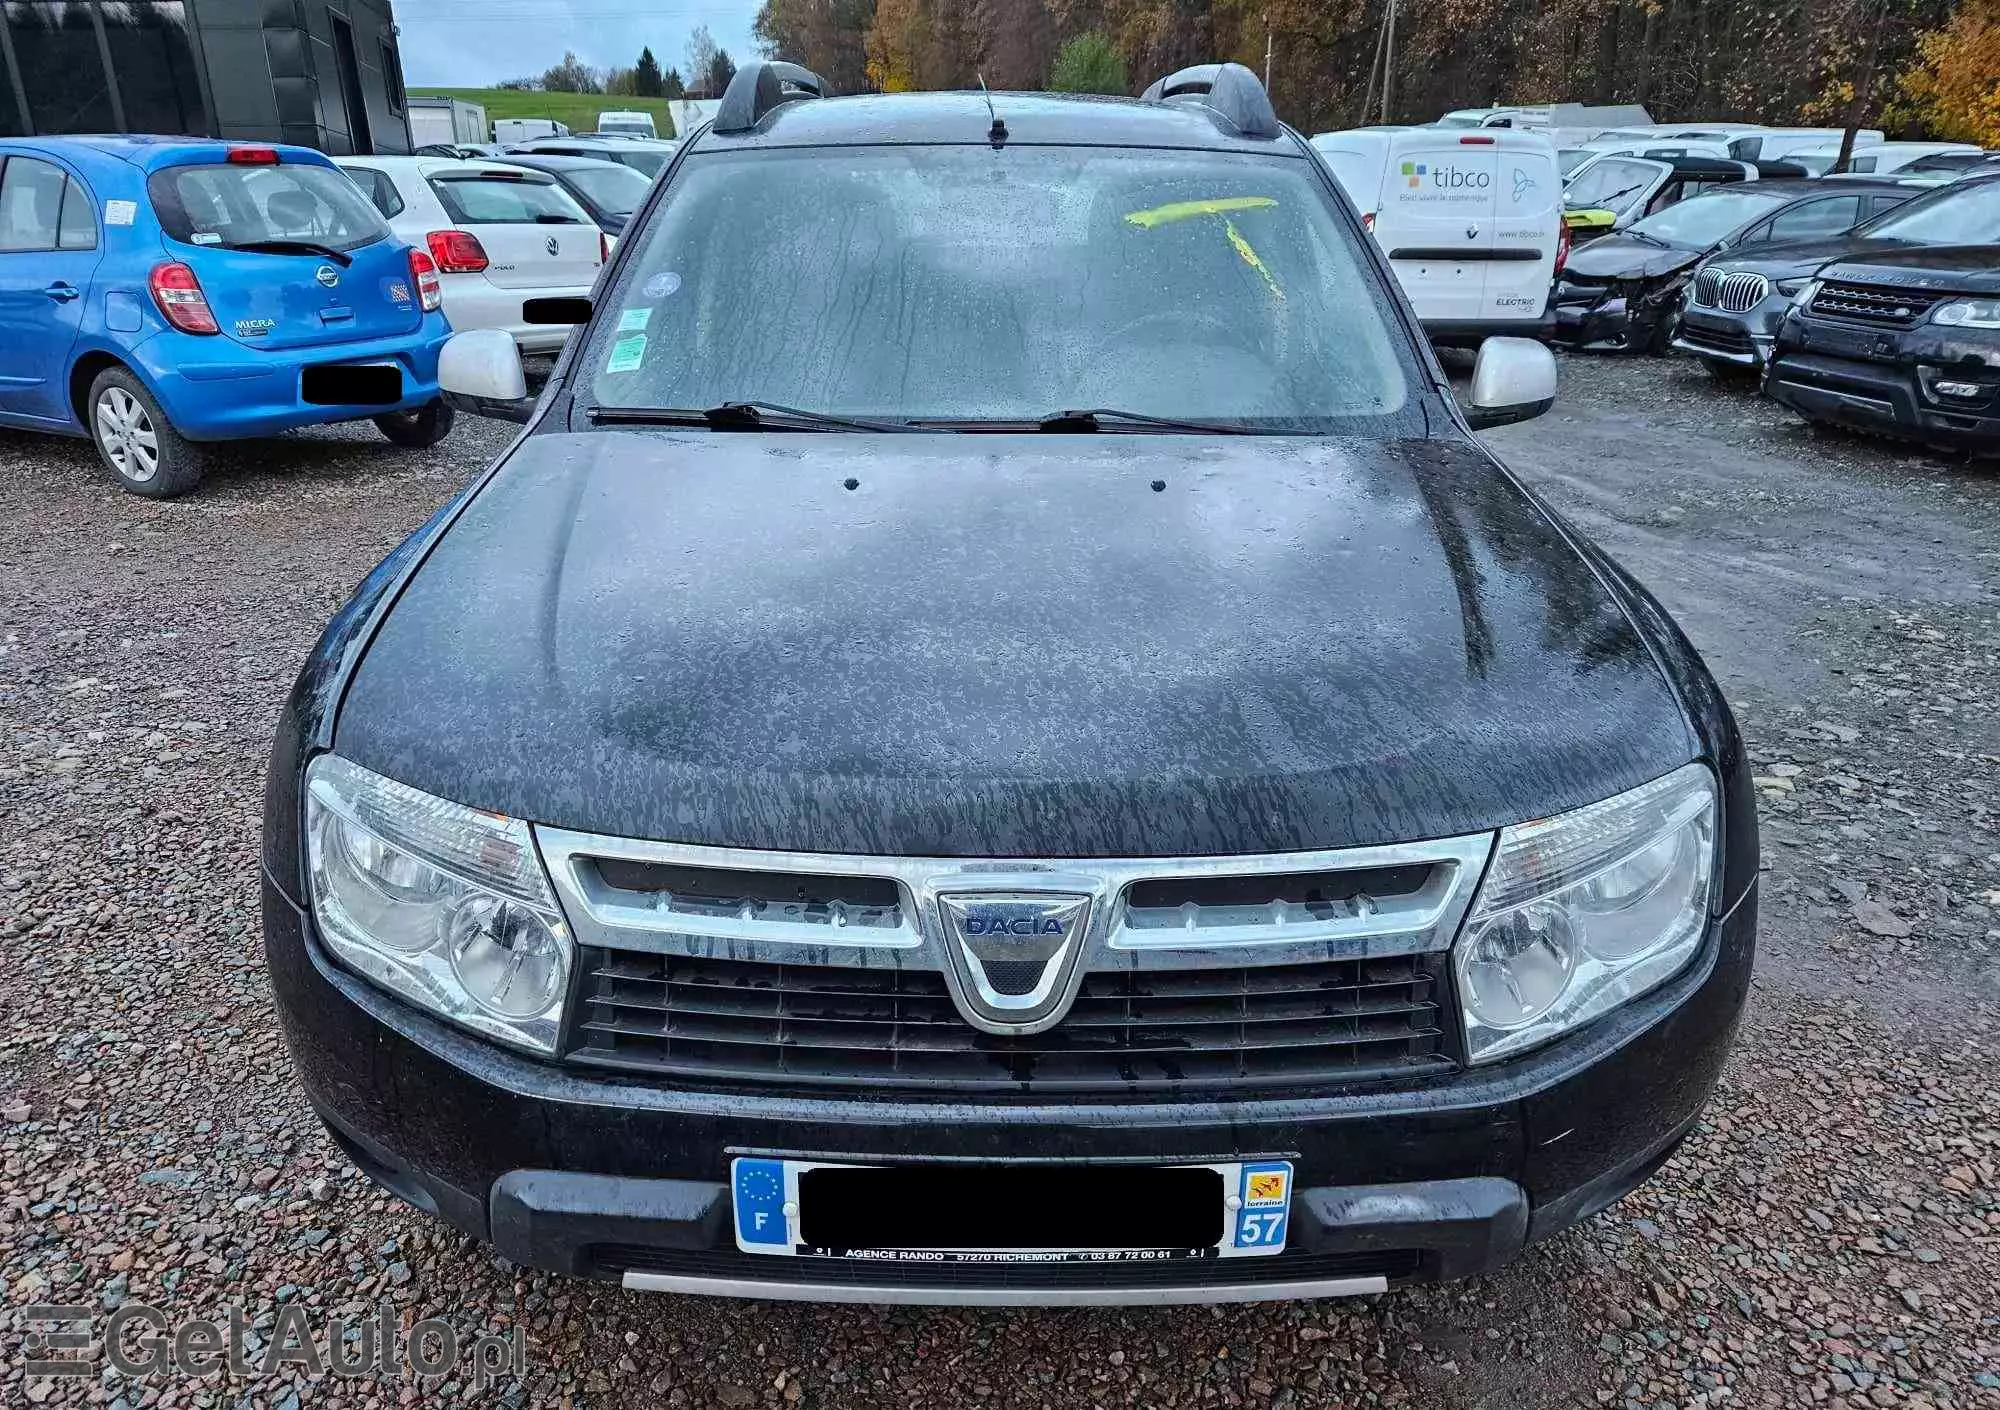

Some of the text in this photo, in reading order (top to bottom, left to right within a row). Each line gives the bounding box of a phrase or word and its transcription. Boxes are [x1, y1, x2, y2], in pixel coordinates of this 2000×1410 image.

[1432, 165, 1490, 188] tibco
[1496, 298, 1535, 306] ELECTRIC
[235, 318, 276, 329] MICRA
[966, 917, 1064, 935] DACIA
[1247, 1199, 1284, 1208] lorraine
[755, 1212, 769, 1231] F
[1241, 1213, 1284, 1244] 57
[845, 1249, 1171, 1262] AGENCE RANDO 57270 RICHEMONT 03 87 72 00 61
